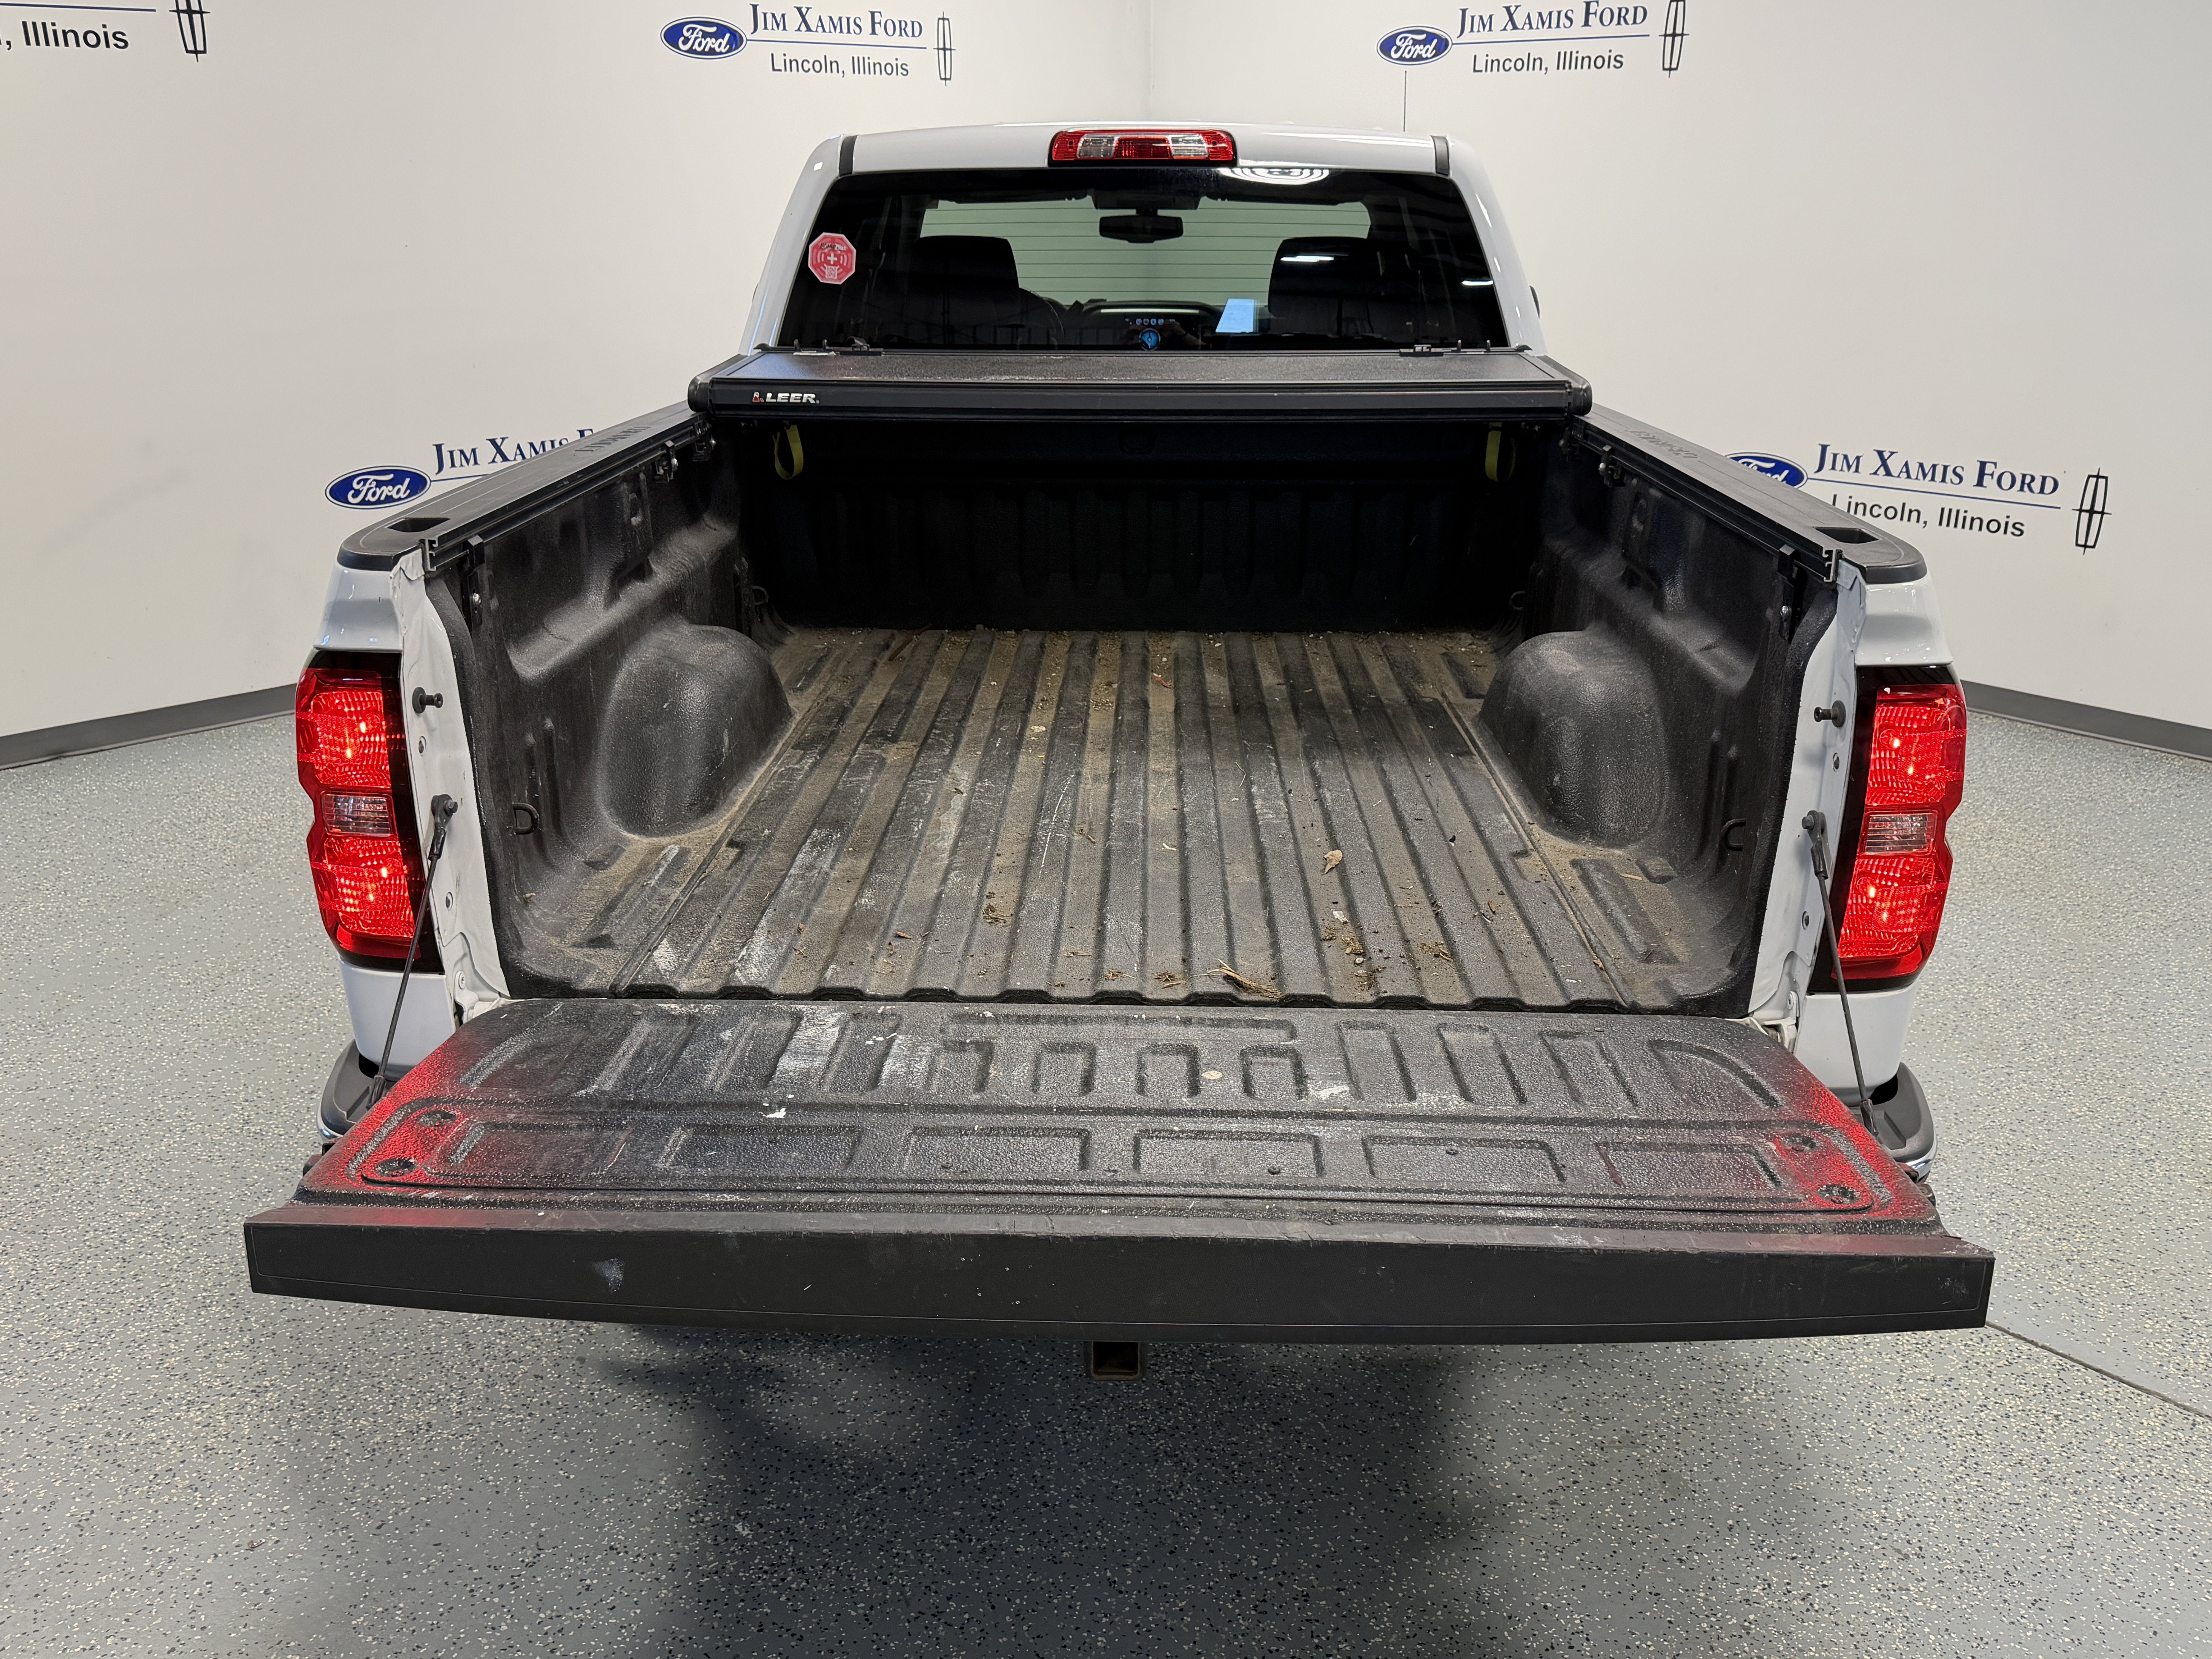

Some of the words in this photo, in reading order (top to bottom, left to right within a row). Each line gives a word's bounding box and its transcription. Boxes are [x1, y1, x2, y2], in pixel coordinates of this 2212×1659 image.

[749, 3, 787, 34] JIM
[793, 6, 862, 35] XAMIS
[868, 10, 922, 38] FORD
[1457, 8, 1494, 38] JIM
[1500, 5, 1574, 32] XAMIS
[1581, 0, 1648, 27] FORD
[22, 21, 129, 50] Illinois
[678, 24, 730, 53] Ford
[1390, 33, 1437, 59] Ford
[771, 53, 845, 78] Lincoln,
[852, 56, 909, 77] Illinois
[1473, 52, 1548, 75] Lincoln,
[1556, 50, 1624, 70] Illinois
[766, 392, 816, 404] LEER
[432, 443, 480, 476] JIM
[1814, 443, 1863, 474] JIM
[1869, 449, 1964, 485] XAMIS
[1973, 459, 2059, 495] FORD
[347, 473, 410, 504] Ford
[1938, 507, 2025, 537] Illinois
